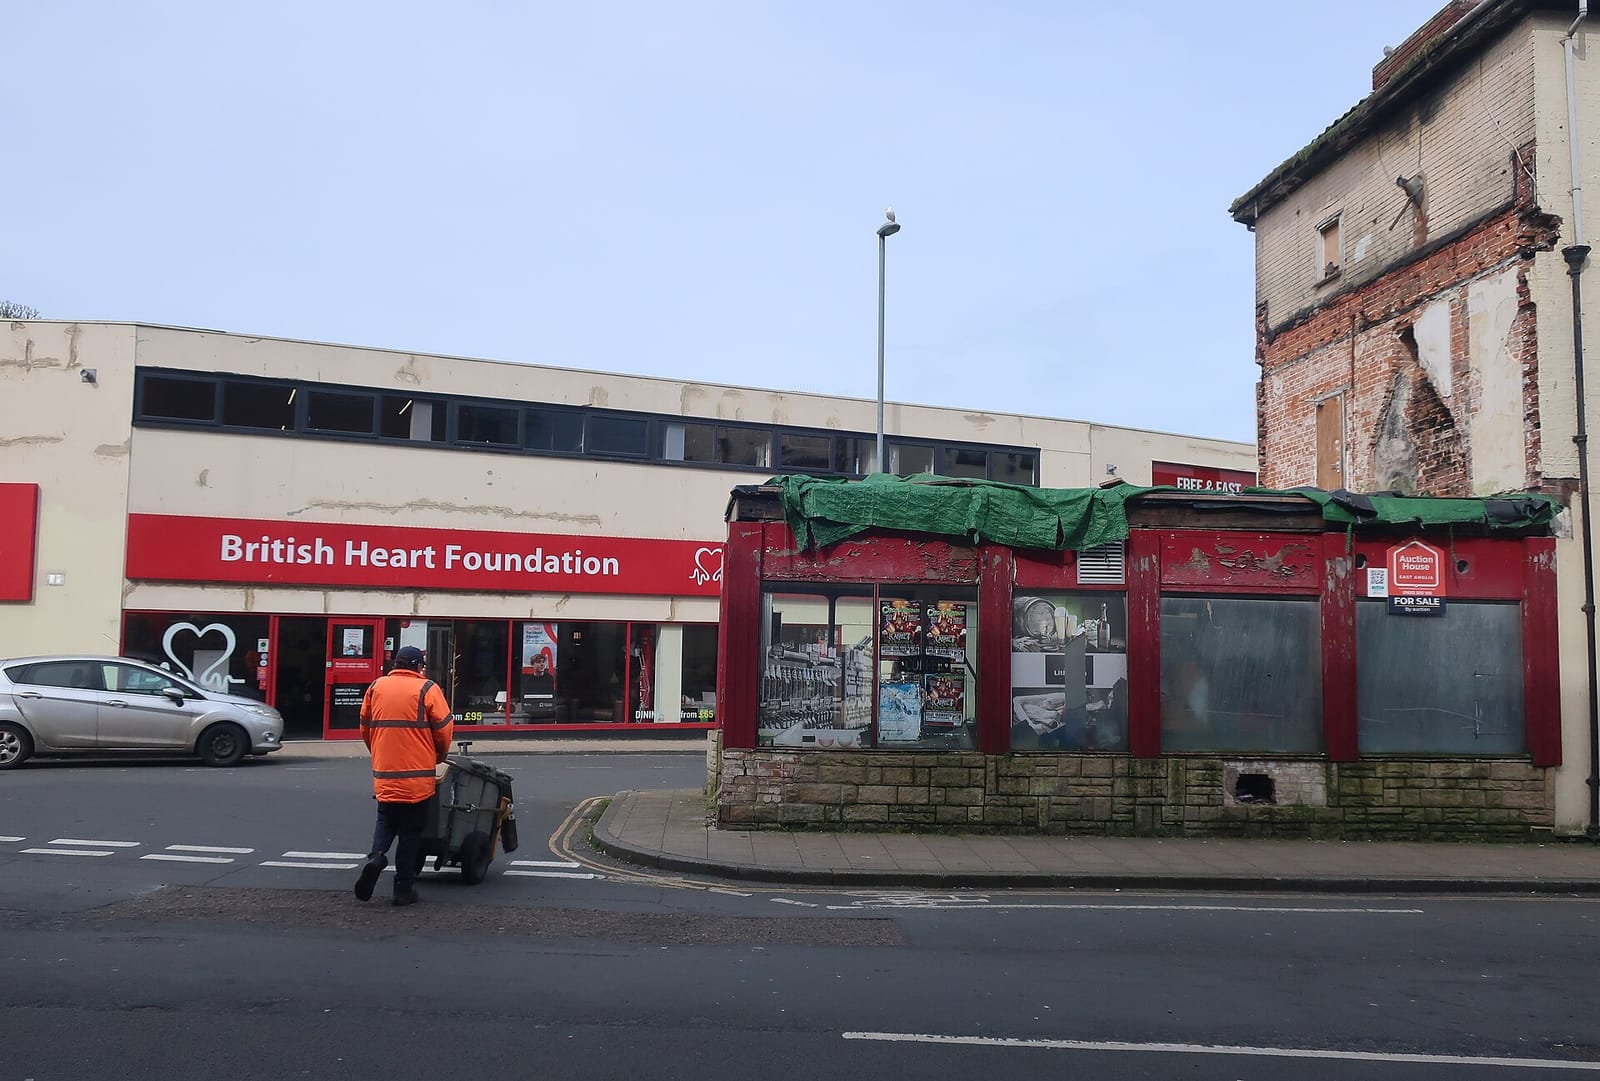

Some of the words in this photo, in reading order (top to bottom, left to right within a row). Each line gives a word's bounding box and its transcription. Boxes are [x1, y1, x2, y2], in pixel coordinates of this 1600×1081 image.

[1177, 477, 1203, 490] FREE
[1206, 480, 1213, 490] &
[220, 534, 334, 565] British
[344, 540, 436, 569] Heart
[445, 544, 619, 576] Foundation
[1399, 555, 1434, 563] Auction
[1402, 563, 1430, 571] House
[1394, 597, 1415, 605] FOR
[1416, 597, 1441, 606] SALE
[464, 711, 482, 721] £95
